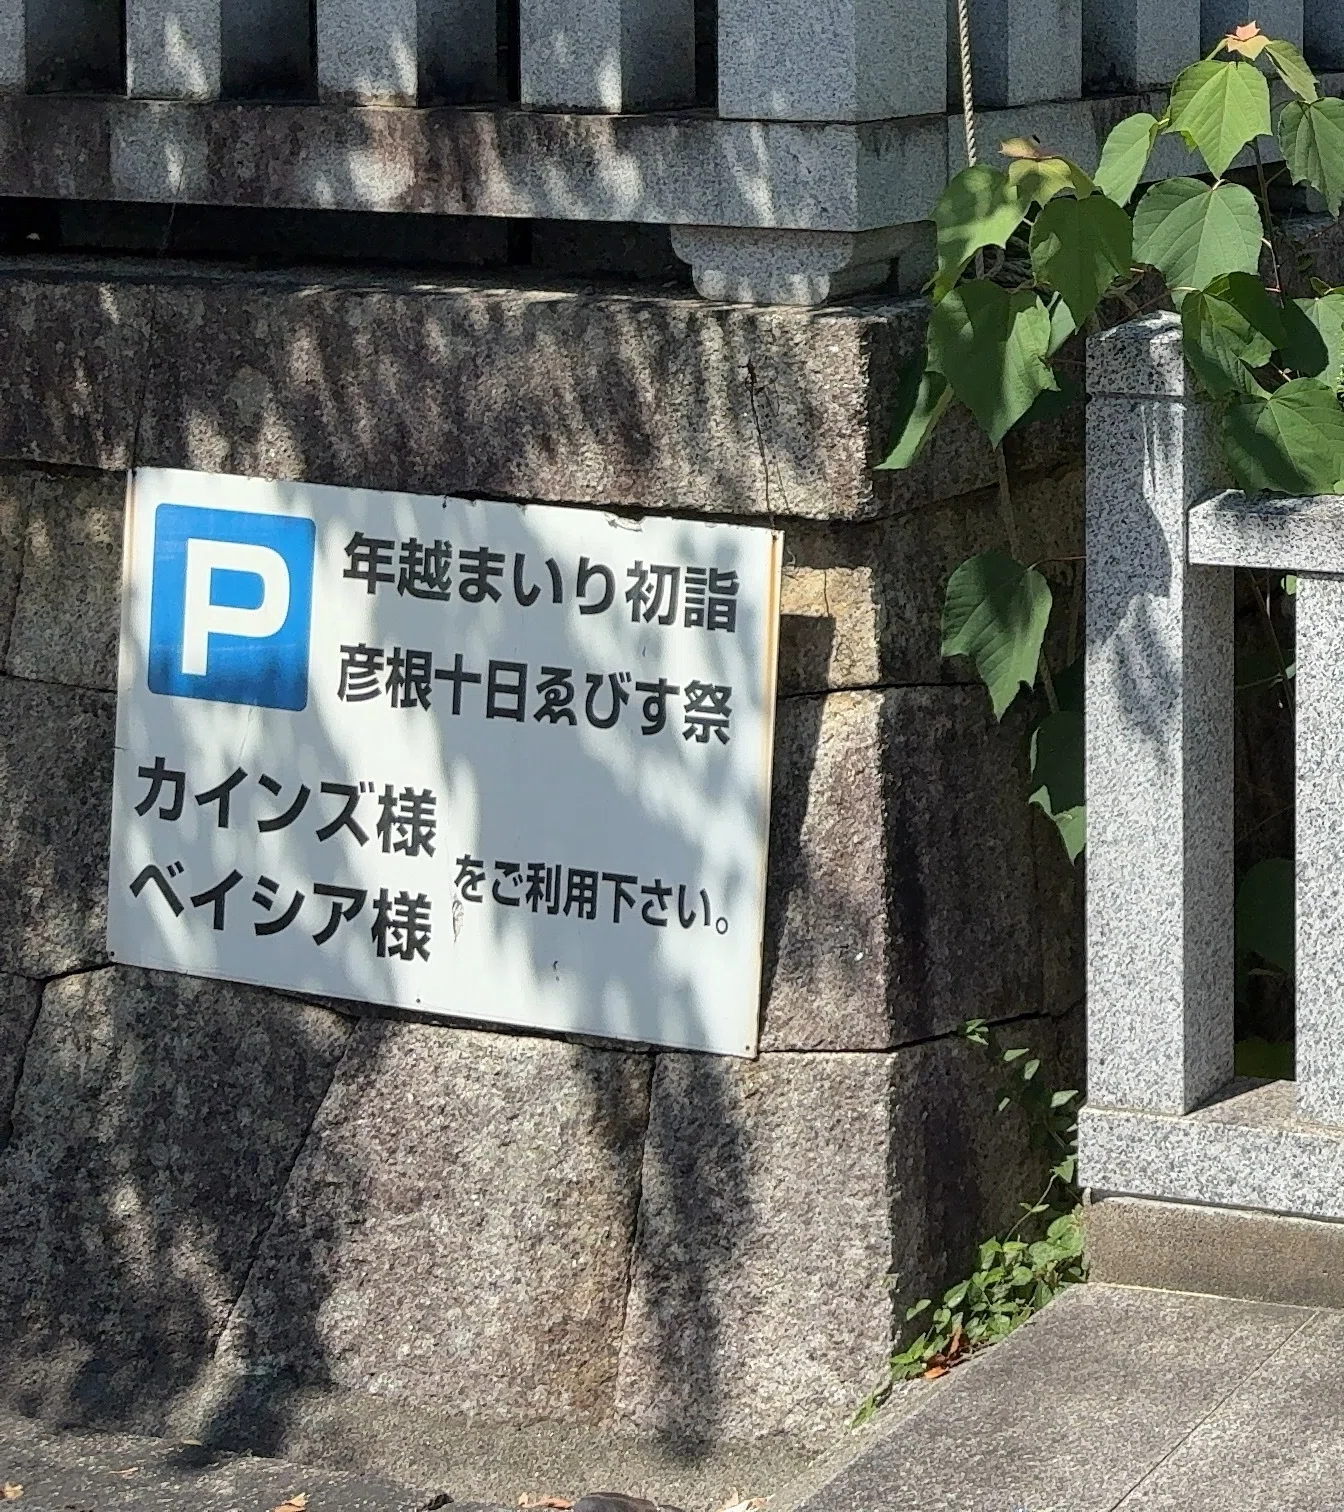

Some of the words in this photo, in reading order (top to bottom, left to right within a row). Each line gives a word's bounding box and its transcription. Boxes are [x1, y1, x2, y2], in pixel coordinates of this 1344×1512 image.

[181, 536, 291, 676] P
[343, 532, 740, 634] 年越まいり初詣
[336, 642, 733, 745] 彦根十日ゑびす祭
[134, 756, 437, 859] カインズ様
[129, 862, 433, 963] ベイシア様
[453, 854, 730, 937] をご利用下さい。
